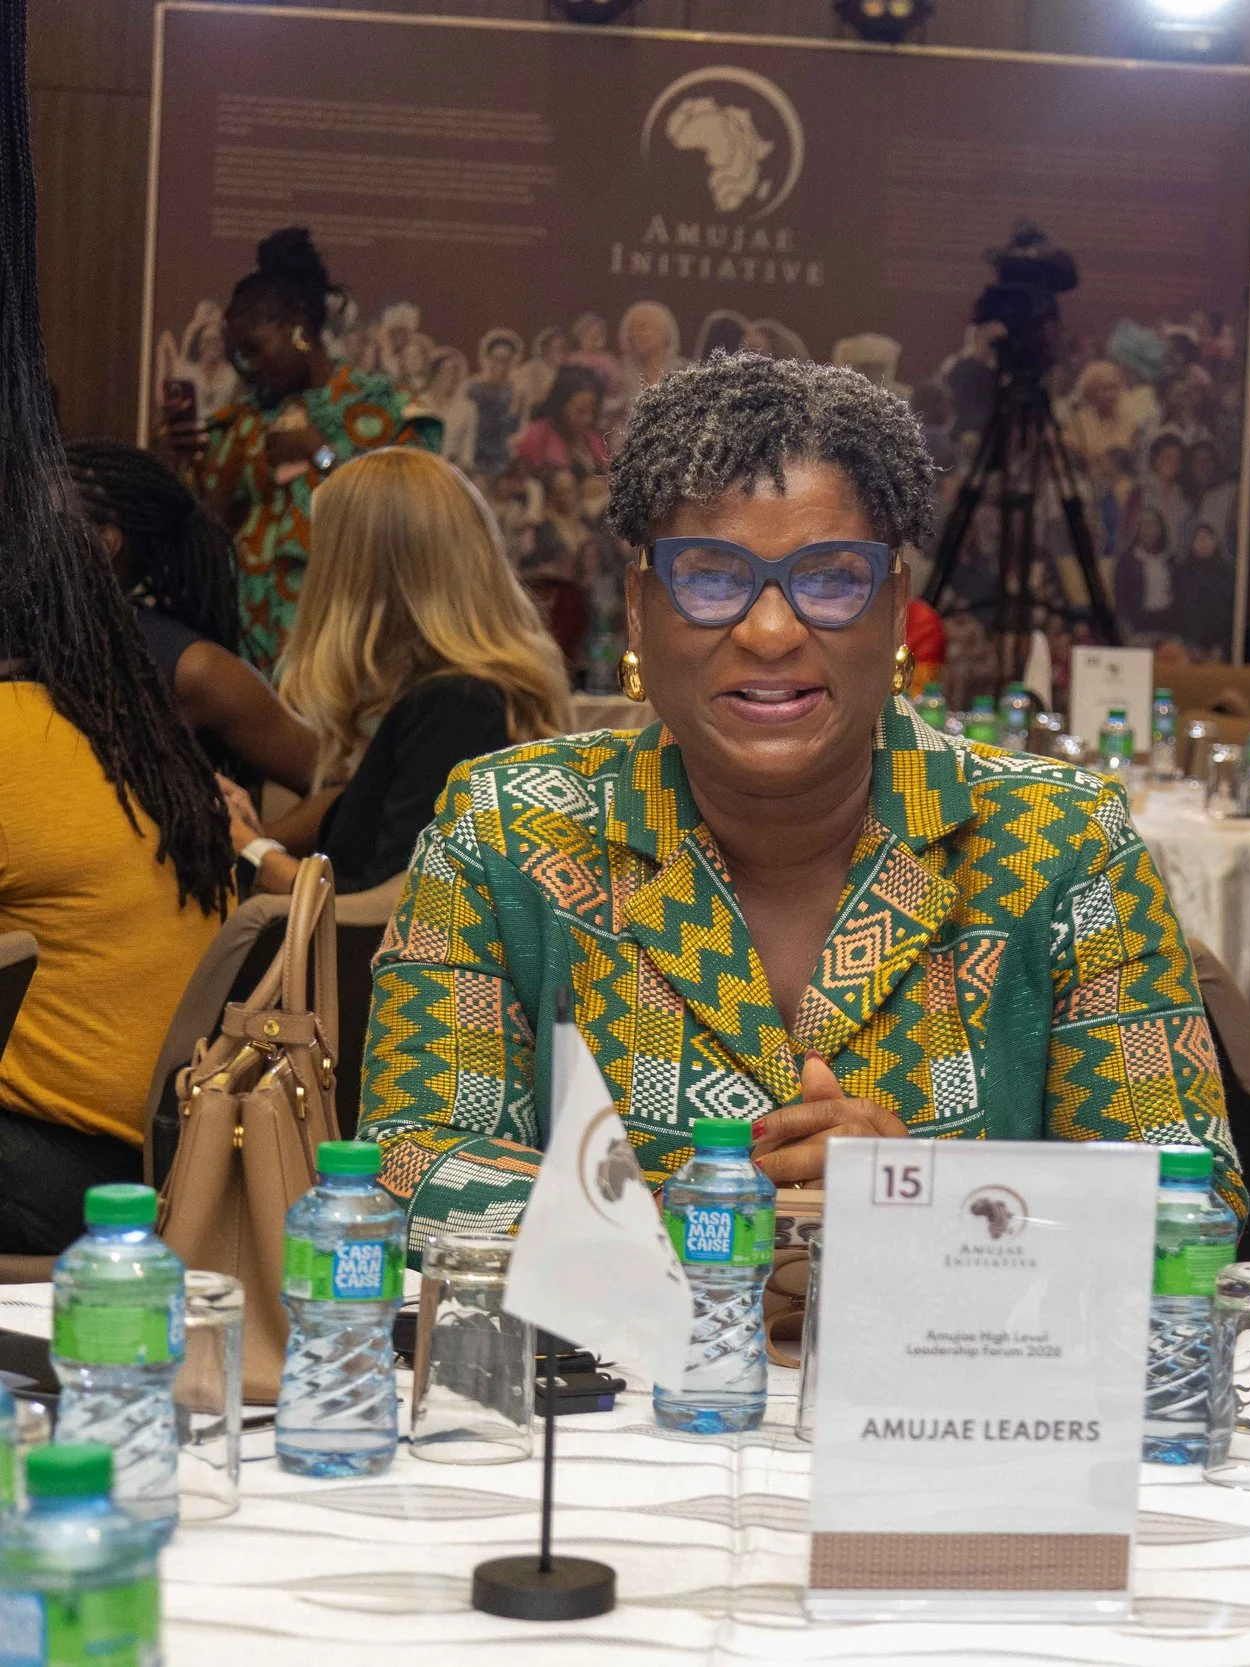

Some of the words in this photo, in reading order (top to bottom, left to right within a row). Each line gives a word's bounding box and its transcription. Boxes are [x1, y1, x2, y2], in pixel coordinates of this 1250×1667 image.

[882, 1165, 923, 1199] 15
[688, 1223, 731, 1239] MAN
[926, 1329, 977, 1344] Amujae
[980, 1330, 1010, 1344] High
[1014, 1331, 1049, 1343] Level
[907, 1344, 980, 1359] Leadership
[983, 1346, 1024, 1357] Forum
[861, 1418, 976, 1440] AMUJAE
[984, 1418, 1101, 1442] LEADERS
